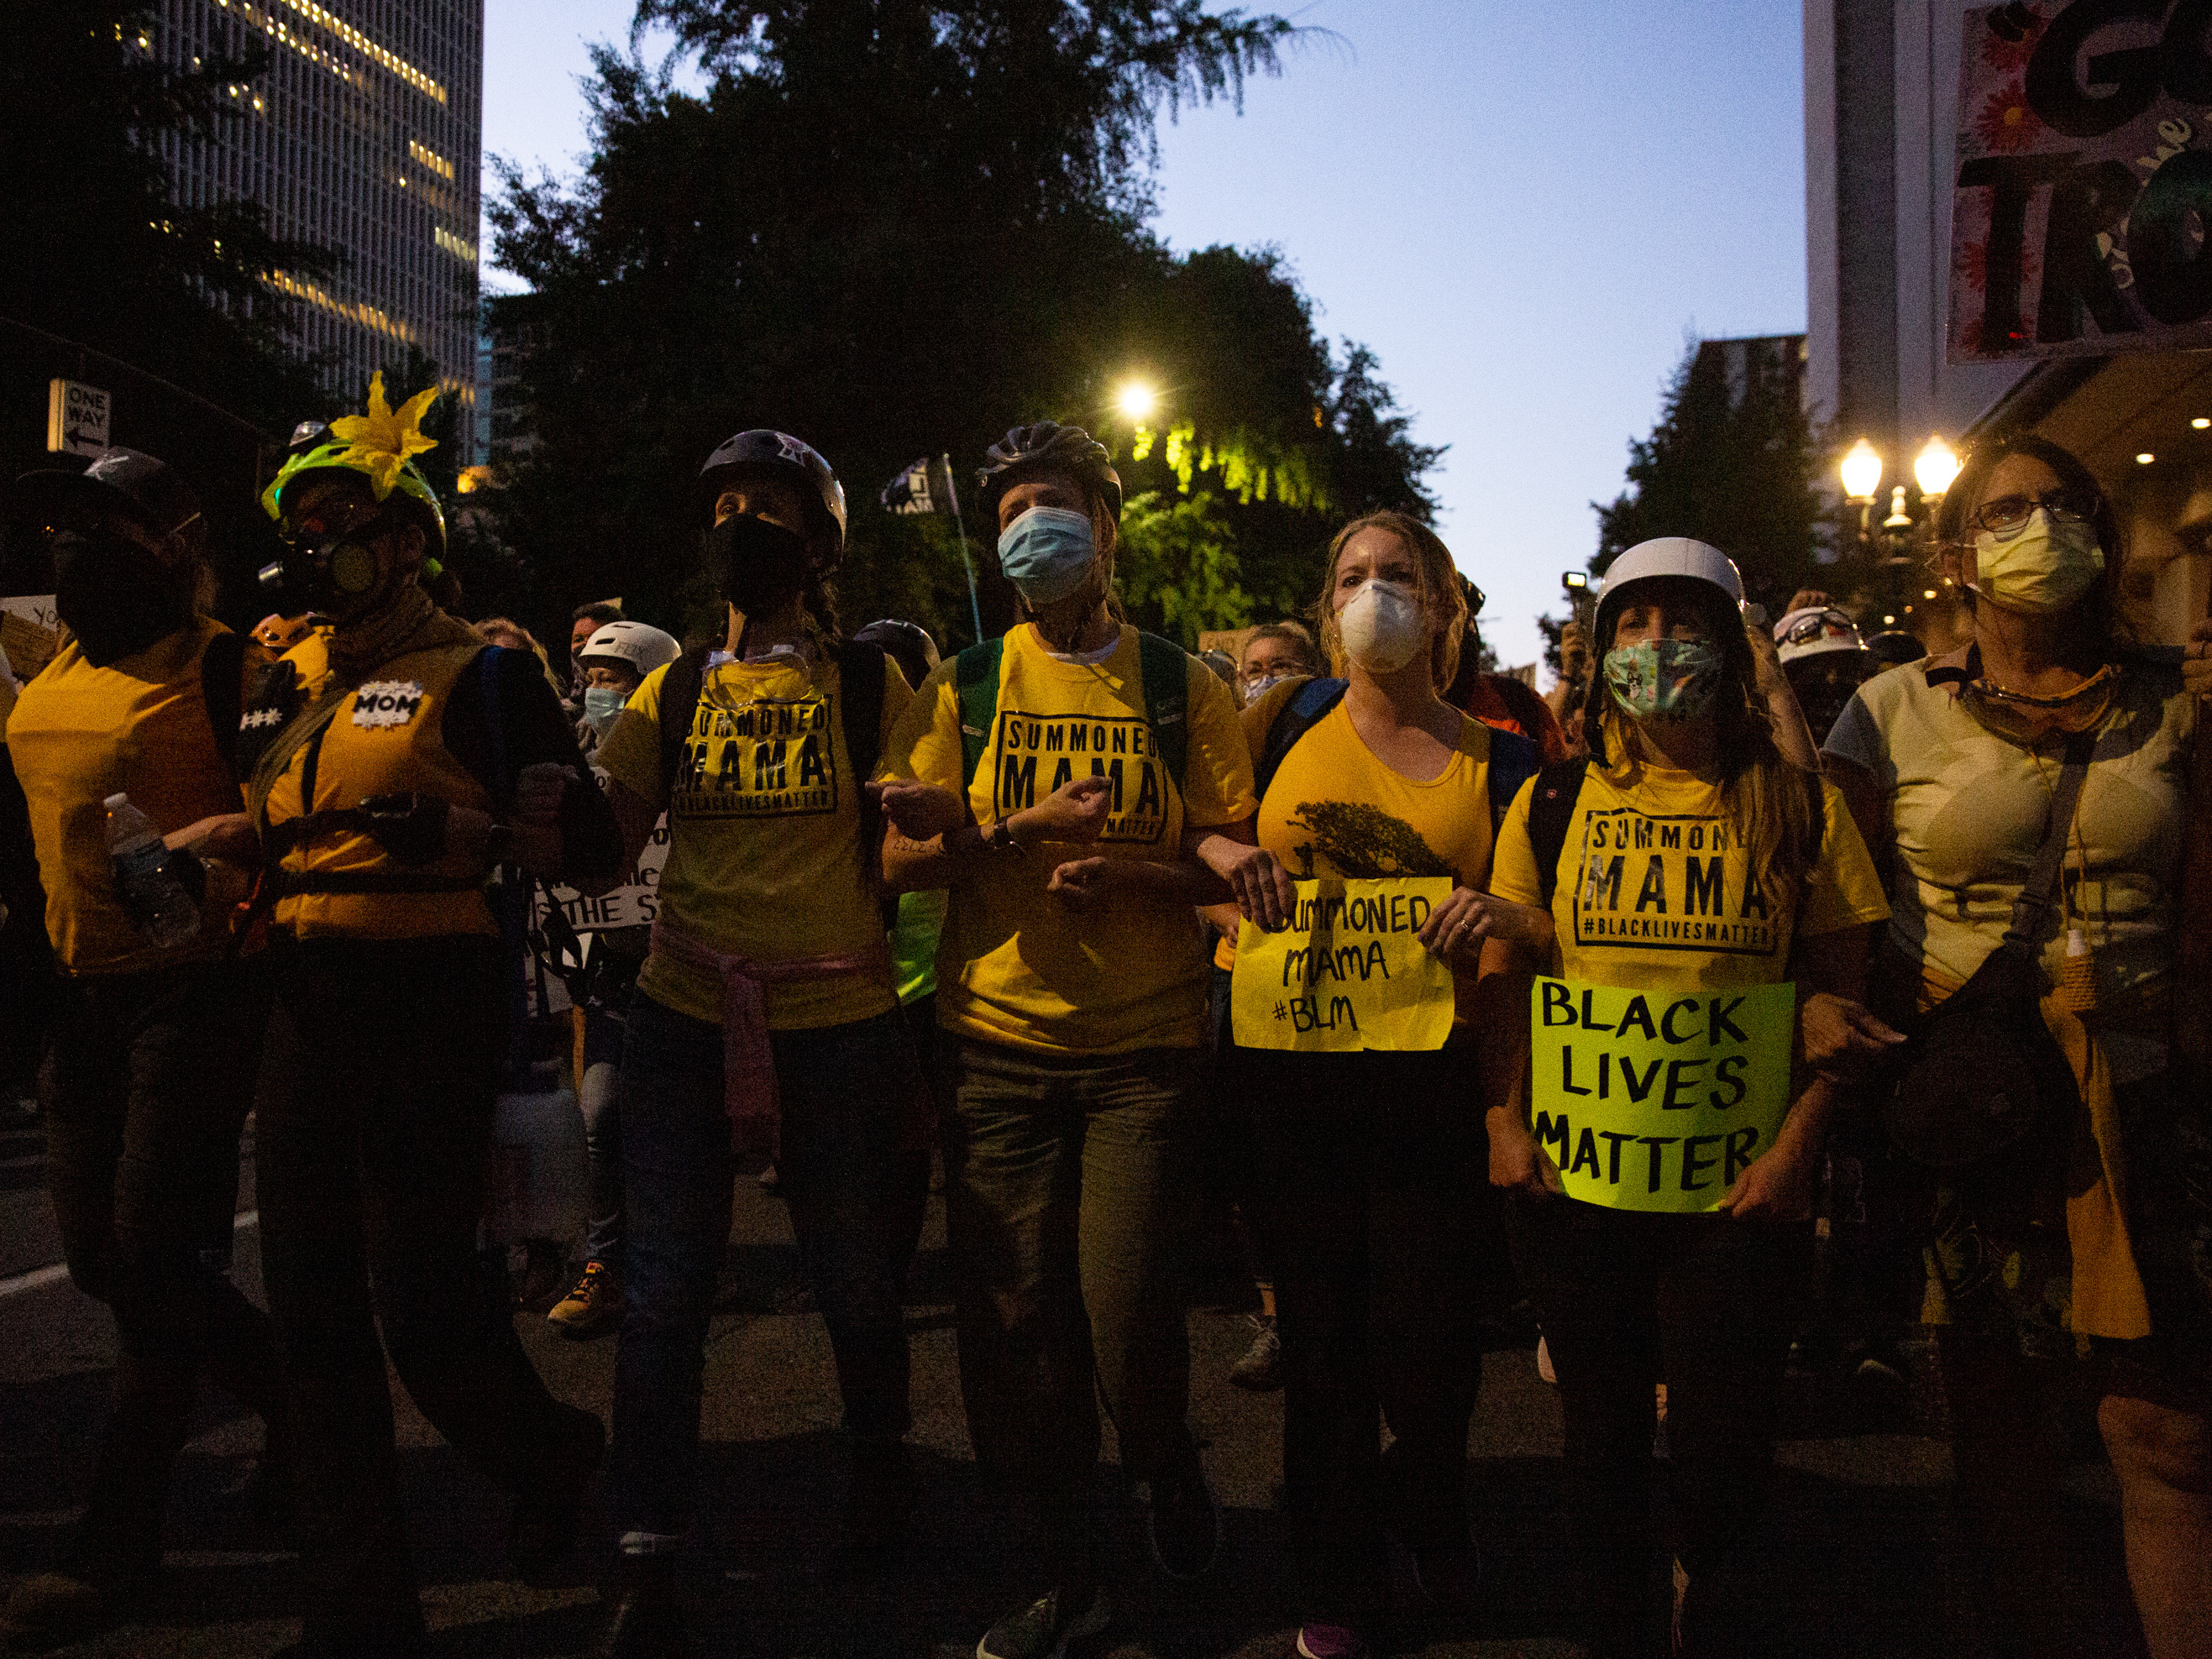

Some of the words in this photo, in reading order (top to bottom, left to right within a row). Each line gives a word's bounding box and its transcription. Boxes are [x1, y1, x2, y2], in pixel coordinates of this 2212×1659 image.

[68, 406, 104, 428] WAY
[70, 388, 105, 410] ONE
[354, 694, 420, 716] MOM
[689, 704, 826, 738] UMMONED
[678, 735, 827, 793] MAMA
[1002, 754, 1161, 815] MAMA
[561, 895, 624, 926] THE
[1583, 854, 1769, 920] MAMA
[1282, 939, 1390, 987] MAMA
[1272, 994, 1359, 1033] #BLM
[1542, 981, 1749, 1047] BLACK
[1562, 1044, 1749, 1110] LIVES
[1533, 1110, 1759, 1193] MATTER
